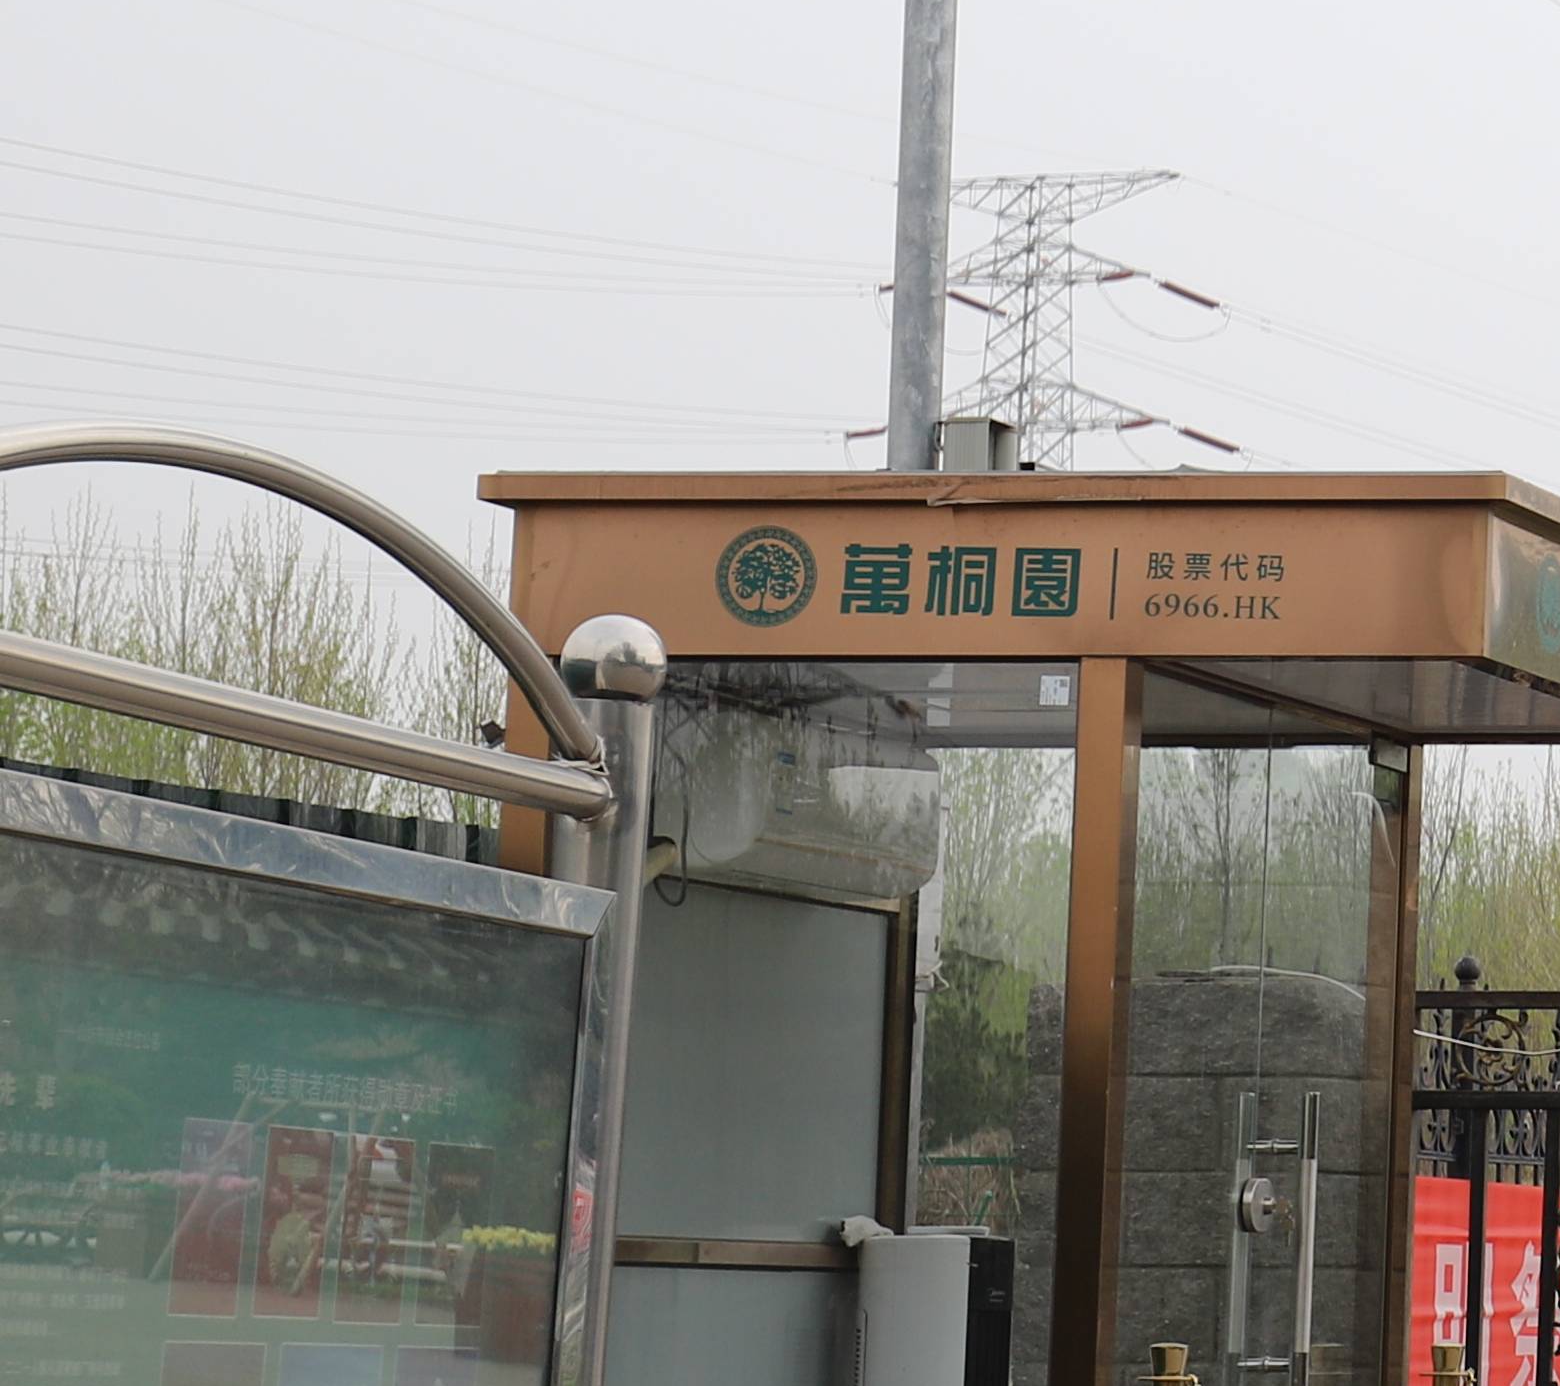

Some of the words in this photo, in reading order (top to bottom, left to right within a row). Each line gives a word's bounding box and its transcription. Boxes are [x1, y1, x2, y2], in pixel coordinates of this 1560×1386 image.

[840, 543, 1082, 618] 萬桐園
[1145, 551, 1286, 583] 股票代码
[1144, 592, 1281, 621] 6966.HK
